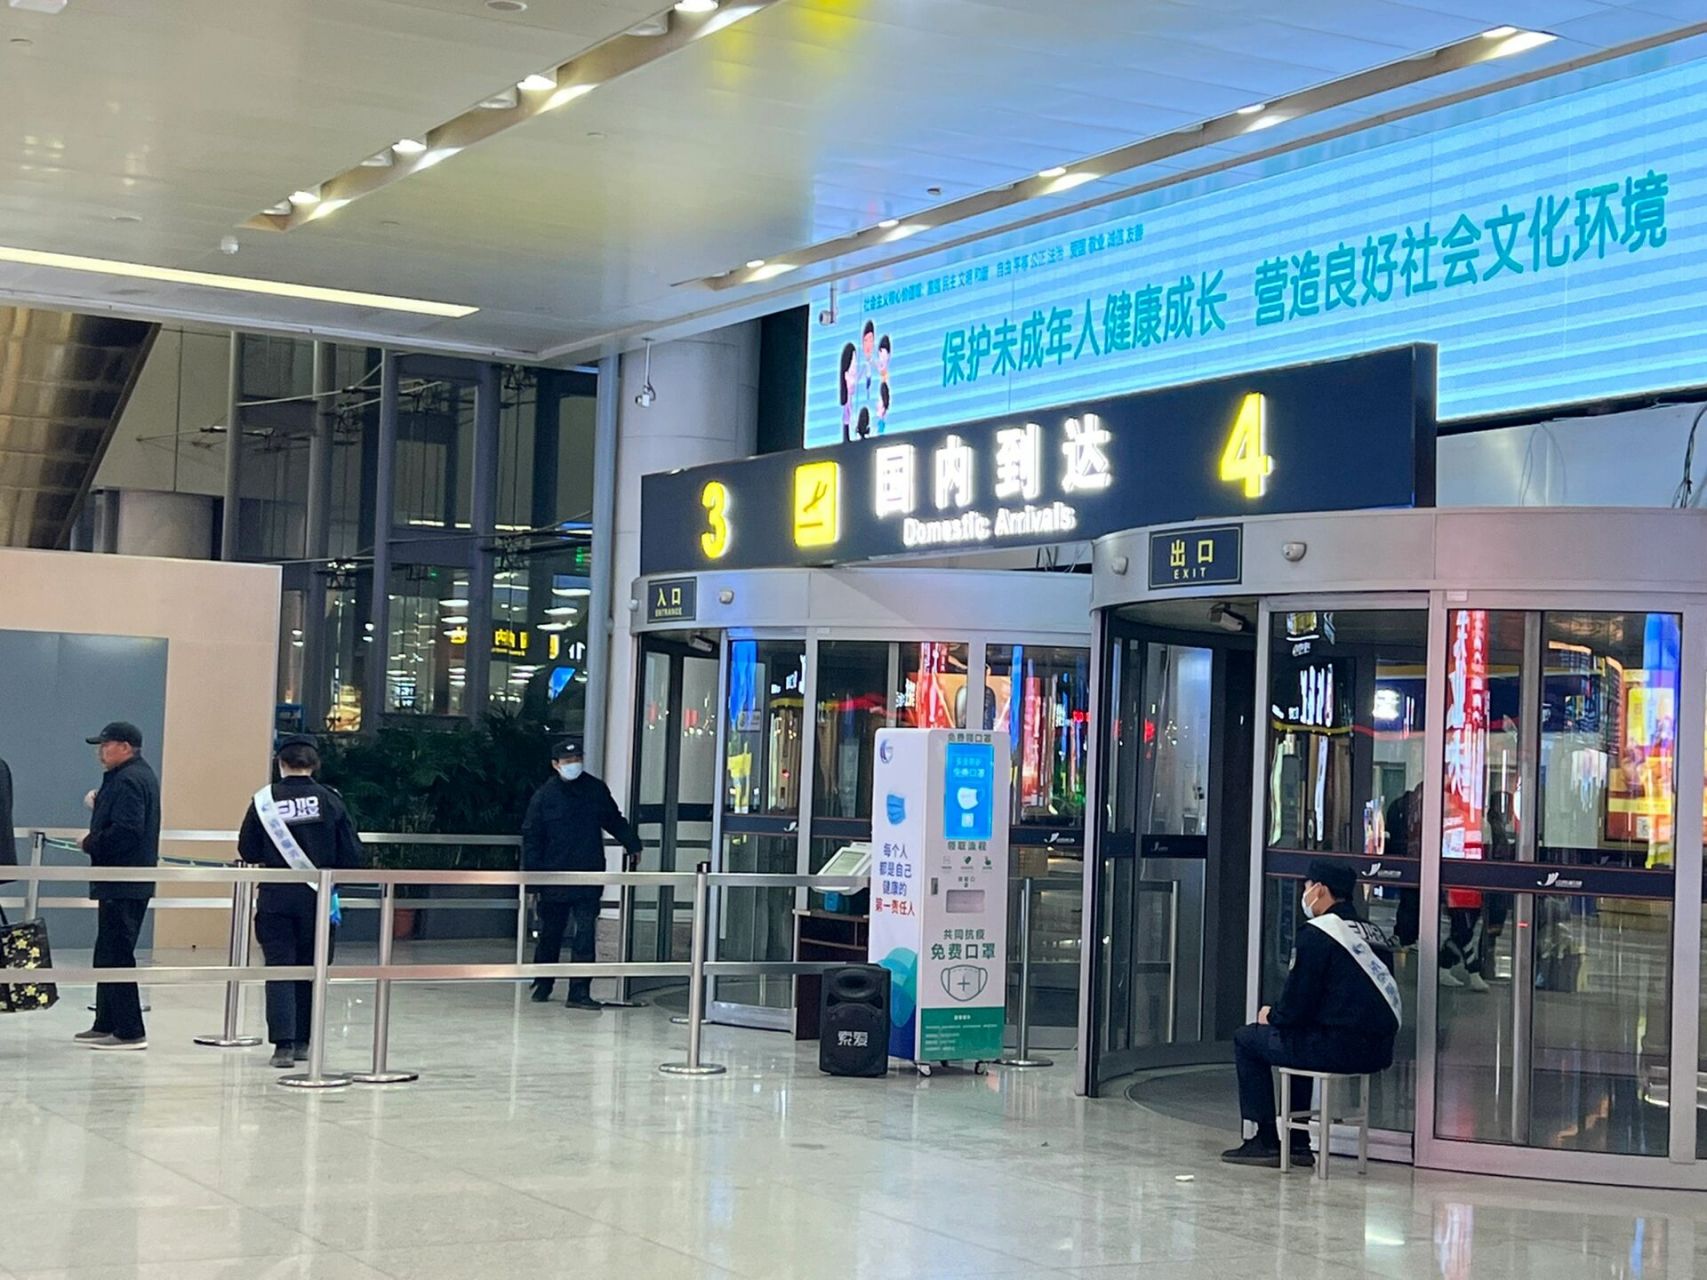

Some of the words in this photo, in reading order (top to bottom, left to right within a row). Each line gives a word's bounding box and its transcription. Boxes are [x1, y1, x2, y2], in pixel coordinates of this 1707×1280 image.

[942, 269, 1228, 388] 保护未成年人健康成长
[1254, 169, 1669, 327] 营造良好社会文化环境
[1219, 391, 1273, 498] 4
[875, 413, 1112, 519] 国内到达
[702, 480, 732, 560] 3
[903, 512, 991, 546] Domestic
[994, 502, 1077, 536] Arrivals
[1170, 539, 1214, 567] 出口
[1173, 567, 1207, 580] EXIT
[656, 587, 682, 607] 入口
[883, 842, 909, 860] 每个人
[879, 861, 913, 878] 都是自己
[882, 880, 908, 897] 健康的
[875, 897, 916, 917] 第一责任人
[943, 928, 986, 940] 共同抗疫
[930, 943, 996, 961] 免费口罩
